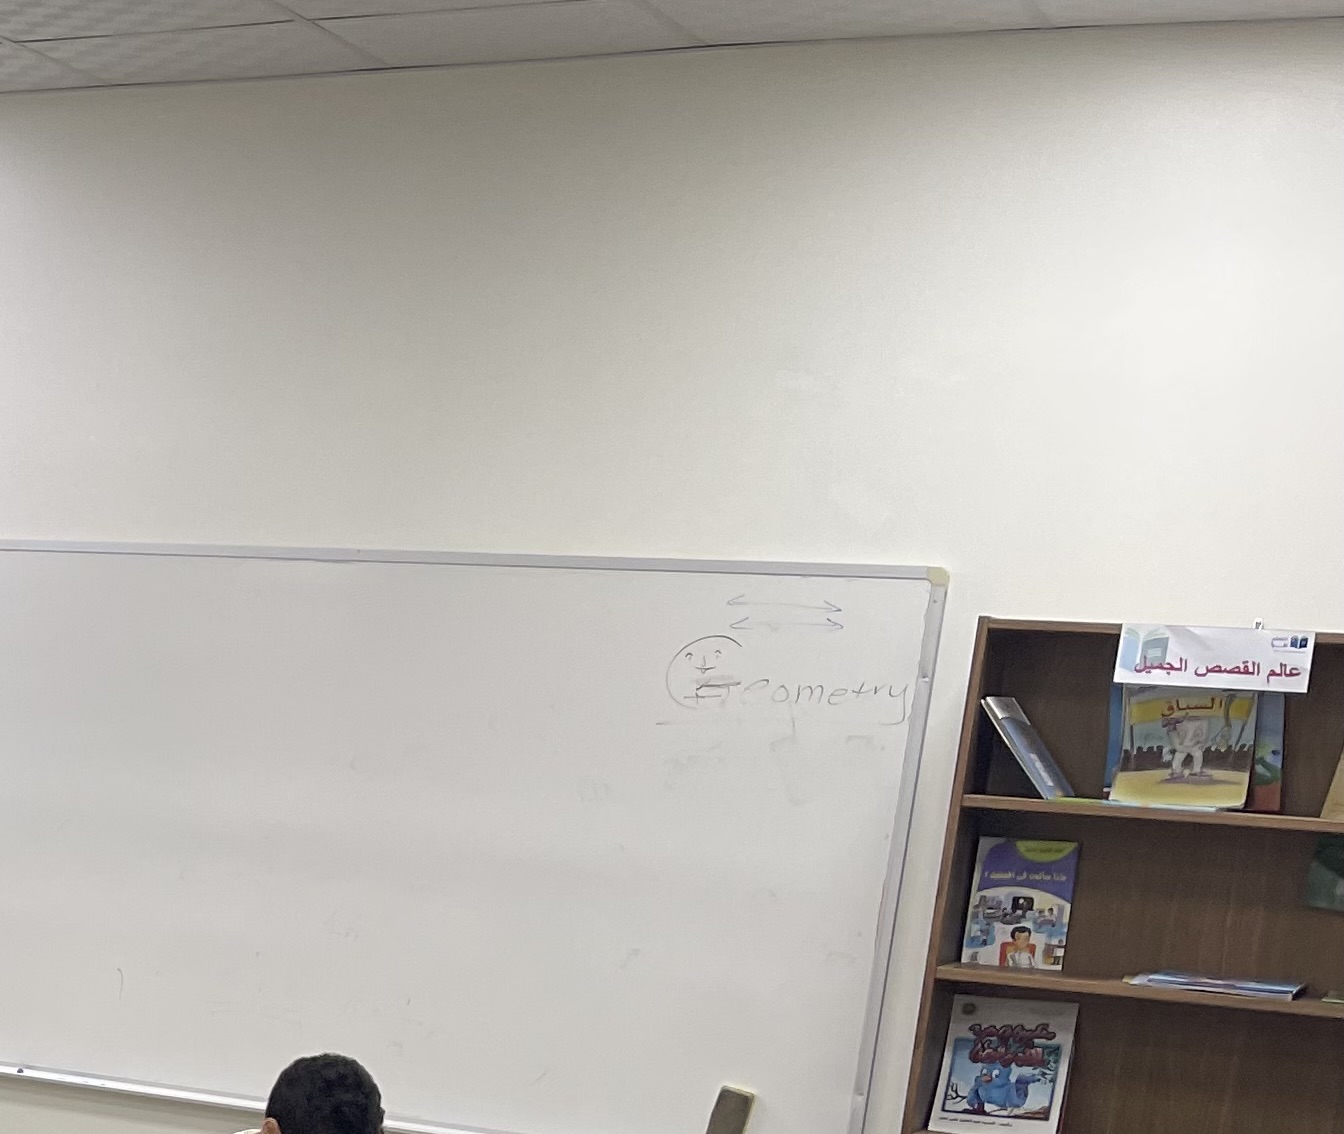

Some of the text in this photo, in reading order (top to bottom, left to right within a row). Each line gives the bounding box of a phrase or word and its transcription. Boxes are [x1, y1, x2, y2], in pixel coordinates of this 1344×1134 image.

[1134, 655, 1301, 684] عالم القصص الجميل
